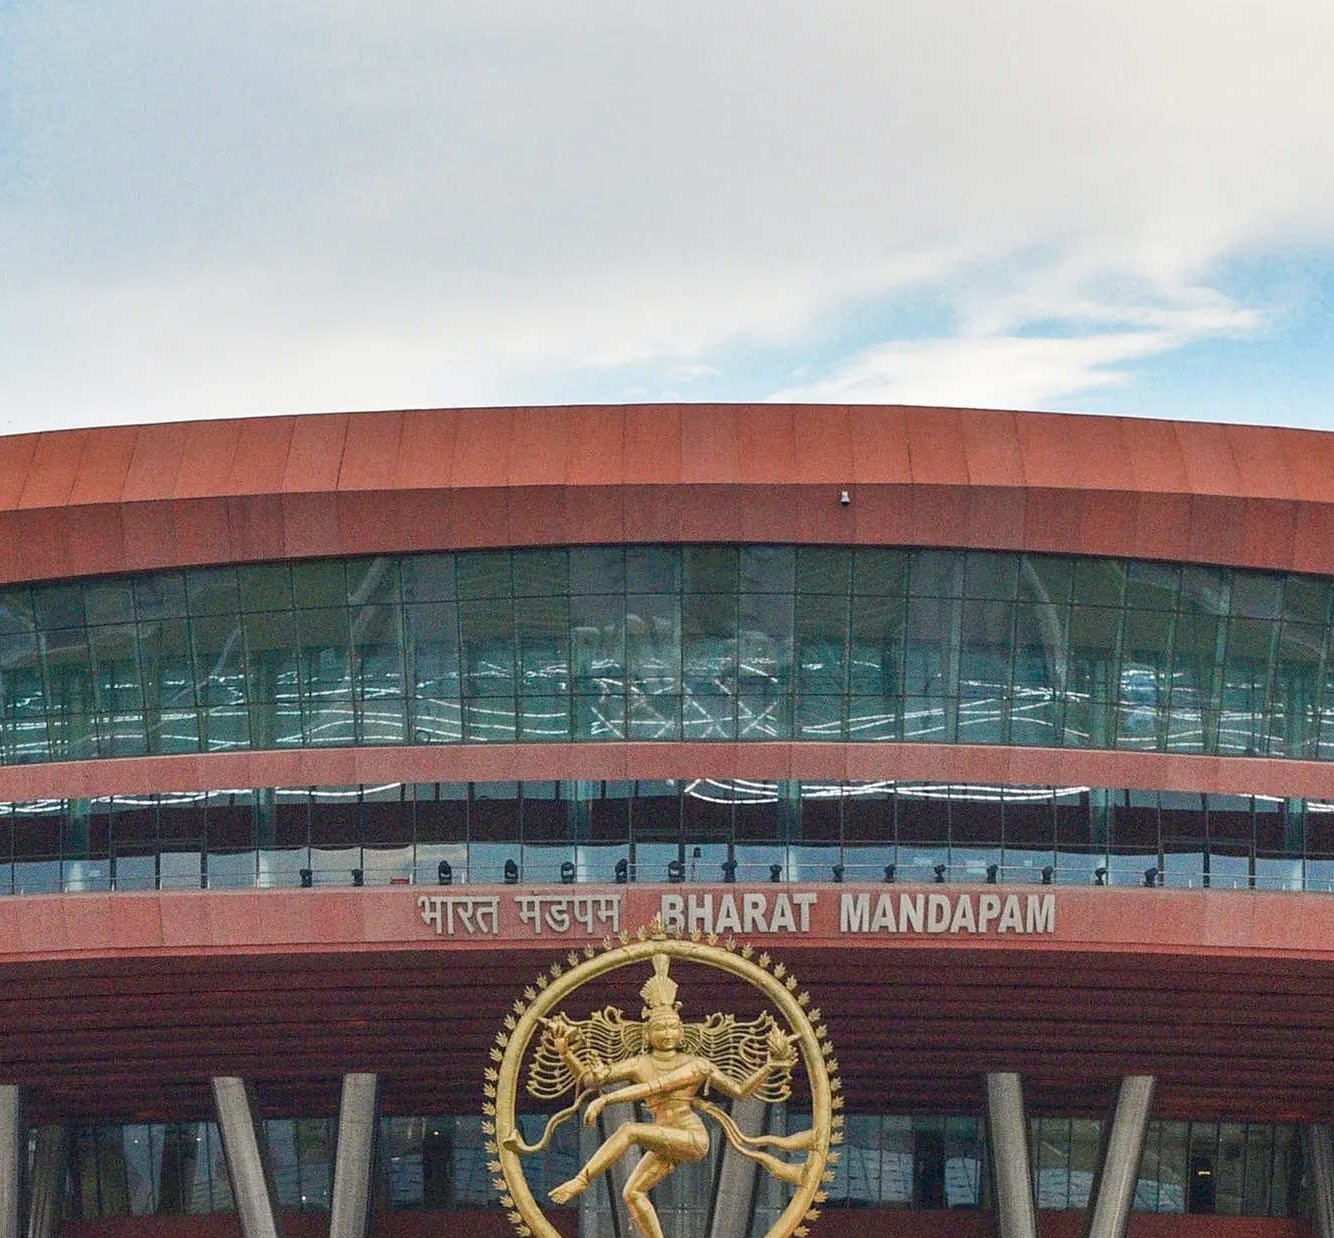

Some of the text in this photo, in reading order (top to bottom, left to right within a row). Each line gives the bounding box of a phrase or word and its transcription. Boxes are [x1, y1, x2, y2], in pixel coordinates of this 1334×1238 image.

[417, 896, 501, 934] भारत
[661, 893, 1056, 934] BHARAT MANDAPAM
